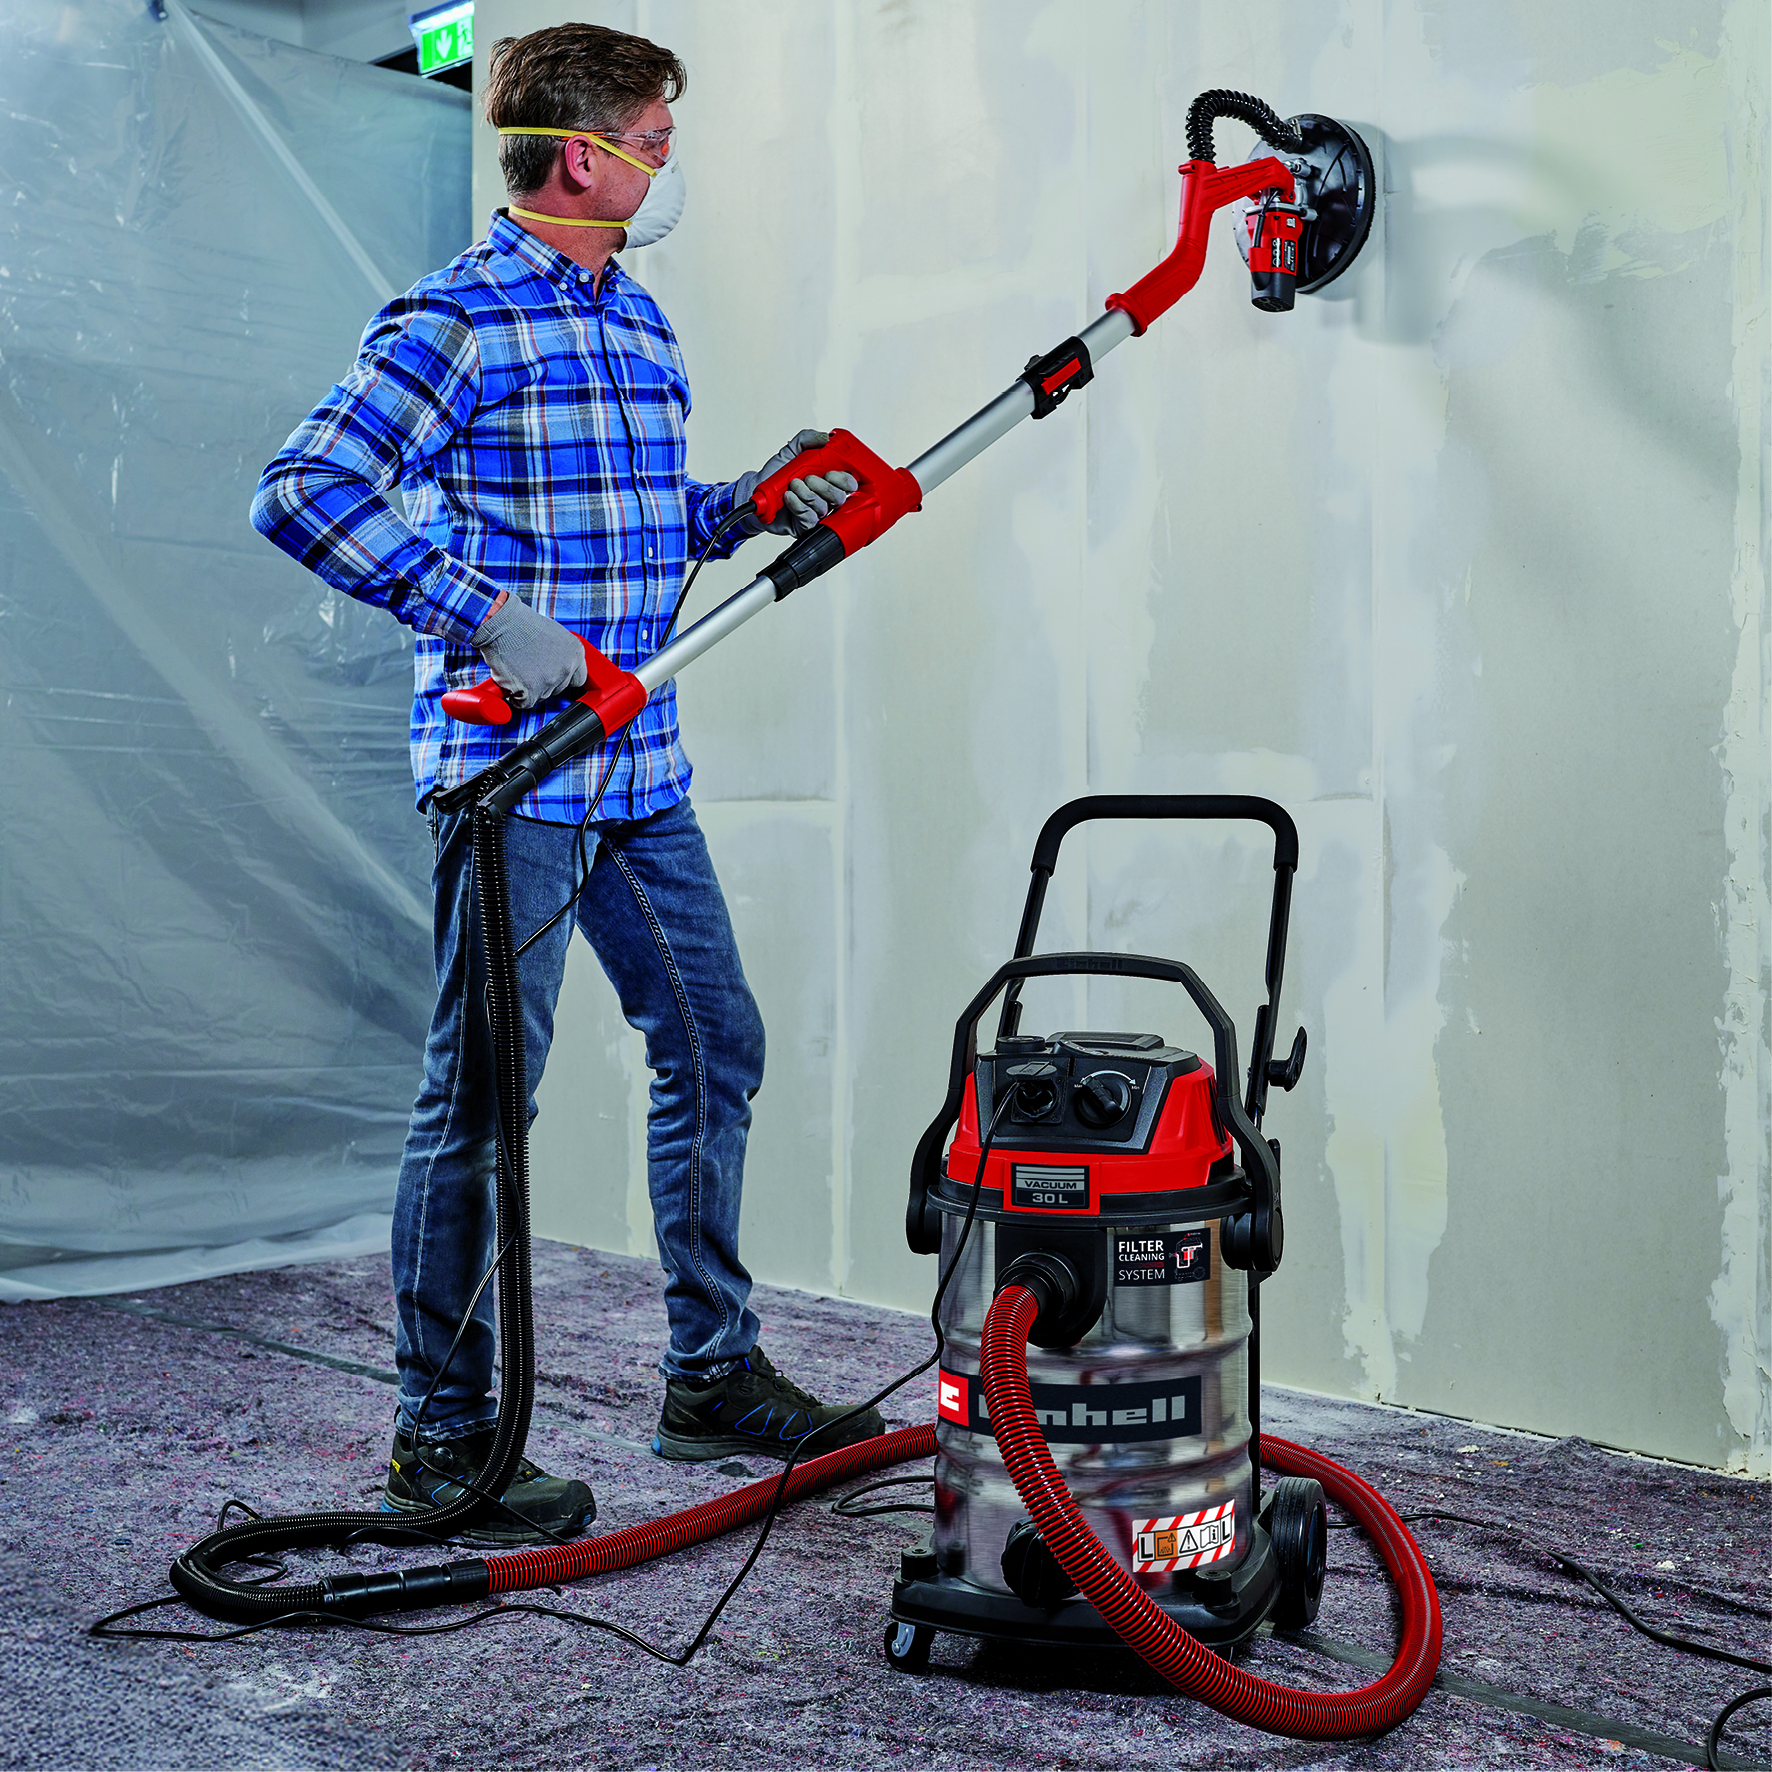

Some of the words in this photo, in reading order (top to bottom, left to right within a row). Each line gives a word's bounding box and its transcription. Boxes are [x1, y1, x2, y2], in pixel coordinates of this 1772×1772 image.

[1024, 1180, 1077, 1190] VACUUM
[1032, 1193, 1055, 1203] 30
[1059, 1193, 1068, 1204] L
[1119, 1240, 1164, 1252] FILTER
[1118, 1252, 1165, 1262] CLEANING
[1119, 1268, 1165, 1281] SYSTEM
[1141, 1537, 1153, 1559] L
[1222, 1520, 1230, 1541] L
